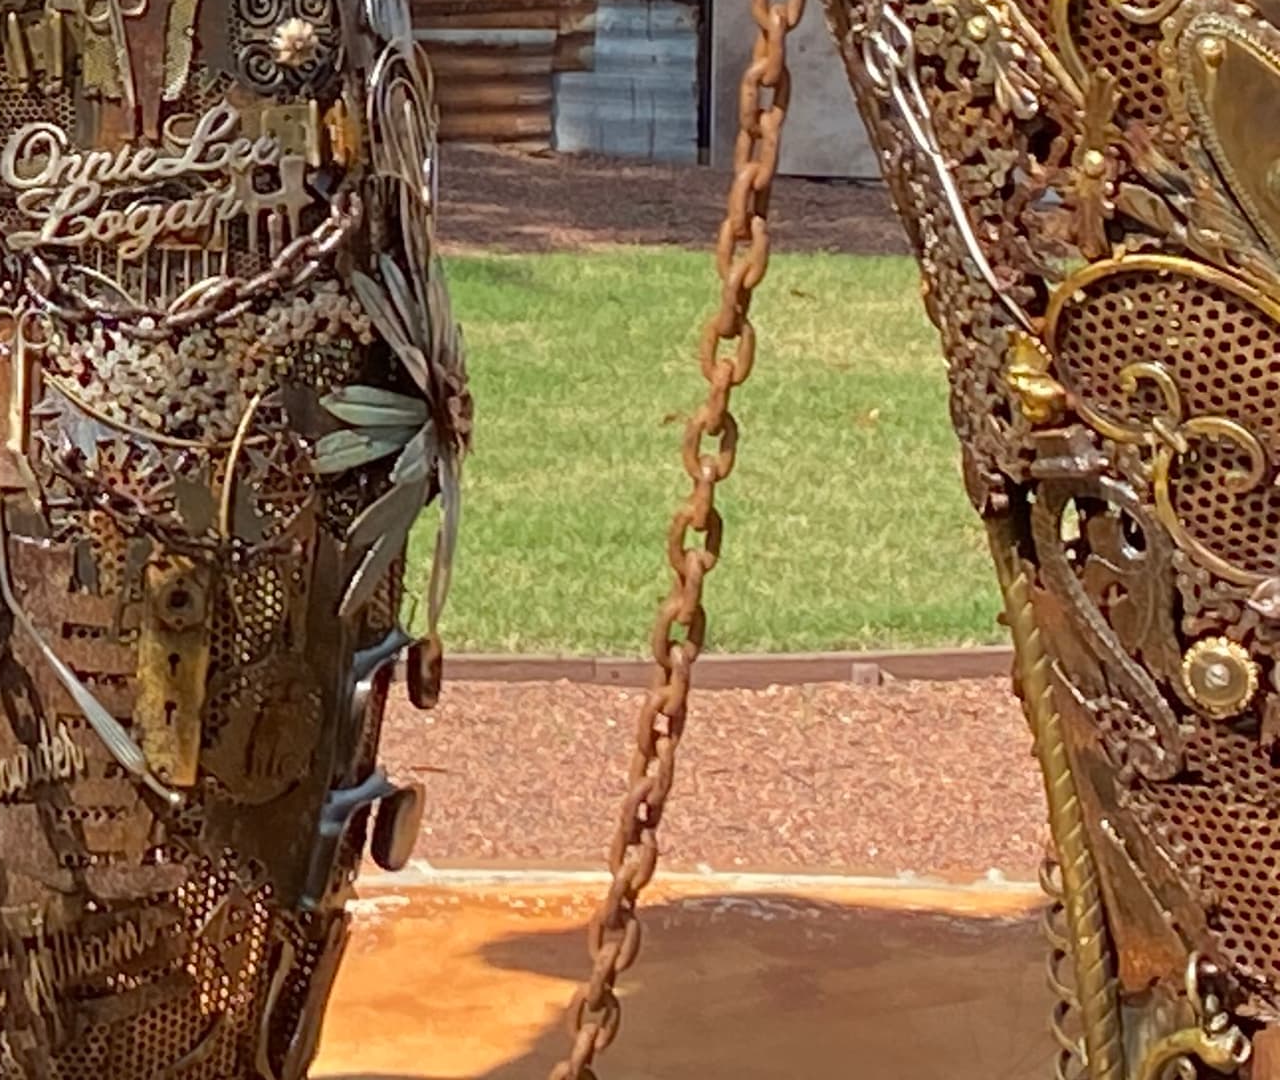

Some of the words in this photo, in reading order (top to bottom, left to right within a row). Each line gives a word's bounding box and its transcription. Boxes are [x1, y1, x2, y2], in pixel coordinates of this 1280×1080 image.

[0, 121, 164, 189] Onnie
[153, 98, 281, 176] Lee
[6, 181, 243, 260] Logan
